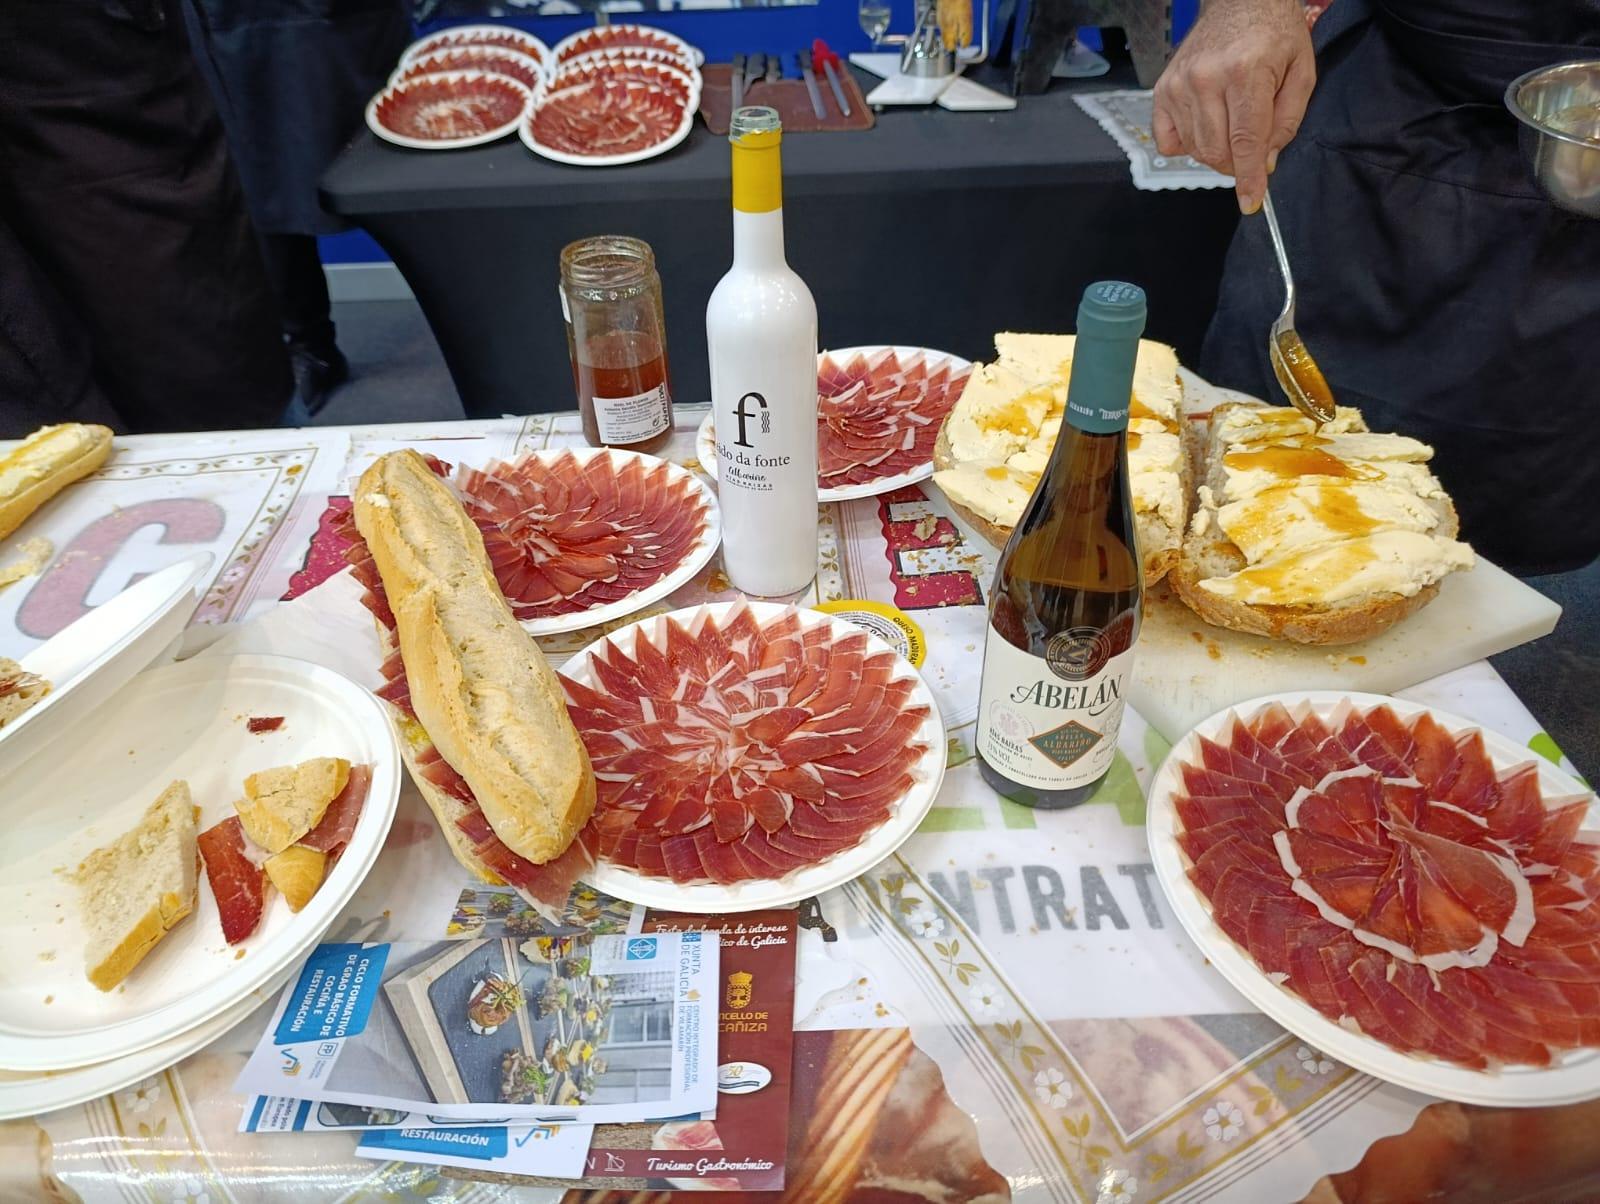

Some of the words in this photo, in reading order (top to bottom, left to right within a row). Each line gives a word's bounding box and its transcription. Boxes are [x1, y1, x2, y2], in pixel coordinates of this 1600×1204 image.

[736, 452, 751, 466] da
[755, 455, 791, 467] fonte
[893, 616, 914, 634] QUESO
[1010, 673, 1123, 716] ABELÁN
[735, 923, 748, 934] de
[749, 923, 788, 933] interese
[681, 944, 691, 956] DE
[736, 935, 750, 947] de
[751, 934, 788, 950] Galicia
[347, 954, 358, 965] DE
[354, 958, 370, 983] CICLO
[691, 944, 702, 975] XUNTA
[338, 967, 353, 991] GRAO
[680, 958, 690, 998] GALICIA
[290, 969, 325, 1032] RESTAURACIÓN
[316, 975, 336, 1008] COCIÑA
[325, 992, 345, 1024] BÁSICO
[335, 984, 361, 1037] FORMATIVO
[692, 1005, 700, 1032] CENTRO
[719, 1012, 754, 1021] NCELLO
[755, 1012, 769, 1020] DE
[320, 1025, 332, 1037] DE
[685, 1005, 693, 1045] FORMACIÓN
[691, 1032, 699, 1073] INTEGRADO
[684, 1046, 692, 1093] PROFESIONAL
[691, 1073, 698, 1083] DE
[400, 1128, 490, 1146] RESTAURACIÓN
[647, 1157, 695, 1171] Turismo
[696, 1157, 774, 1176] Gastronómico
